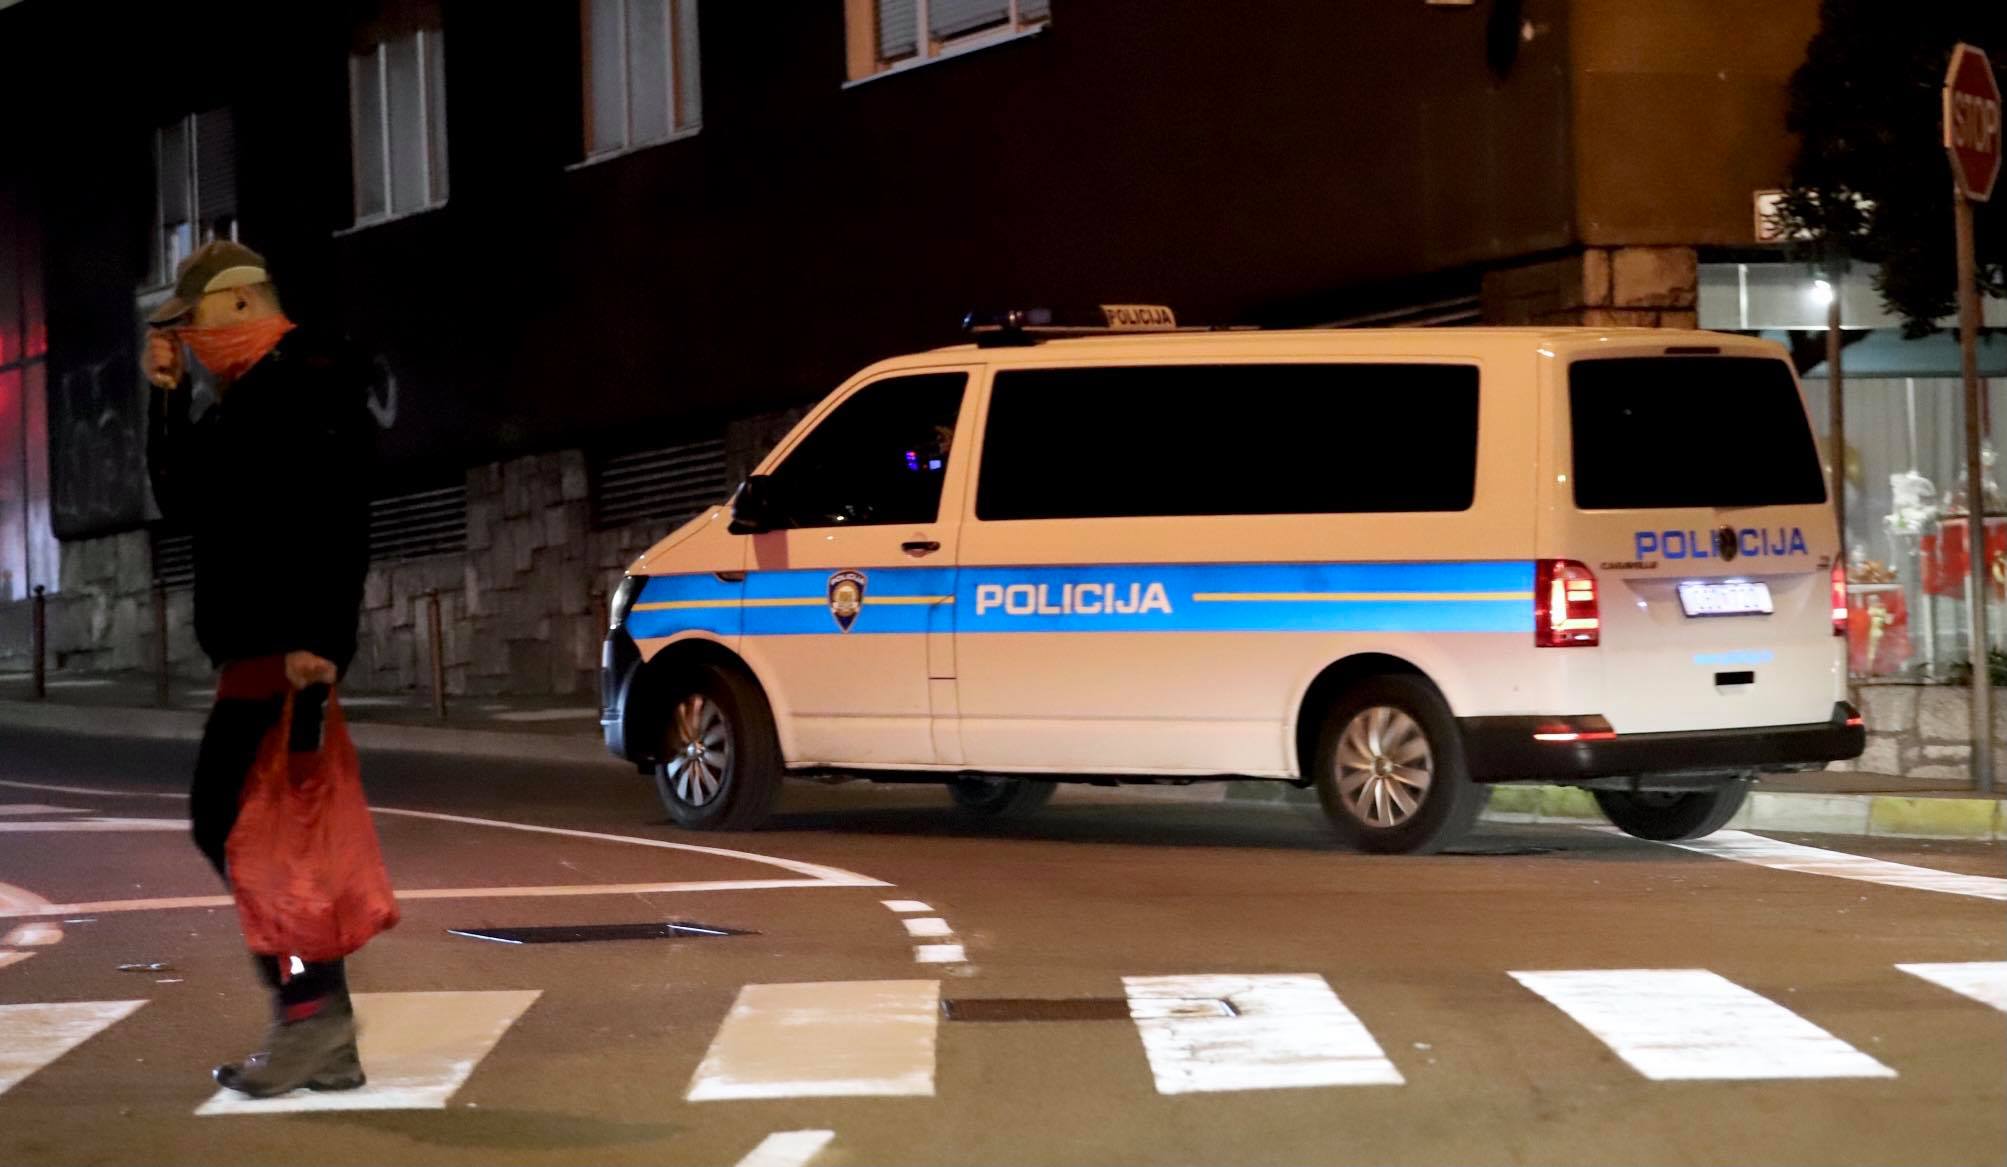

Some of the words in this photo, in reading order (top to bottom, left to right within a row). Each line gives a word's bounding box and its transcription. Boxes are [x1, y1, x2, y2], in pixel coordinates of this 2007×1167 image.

[1953, 90, 1998, 152] STOP
[1108, 308, 1171, 325] POLICIJA
[1635, 528, 1807, 559] POLICIJA
[975, 583, 1172, 615] POLICIJA
